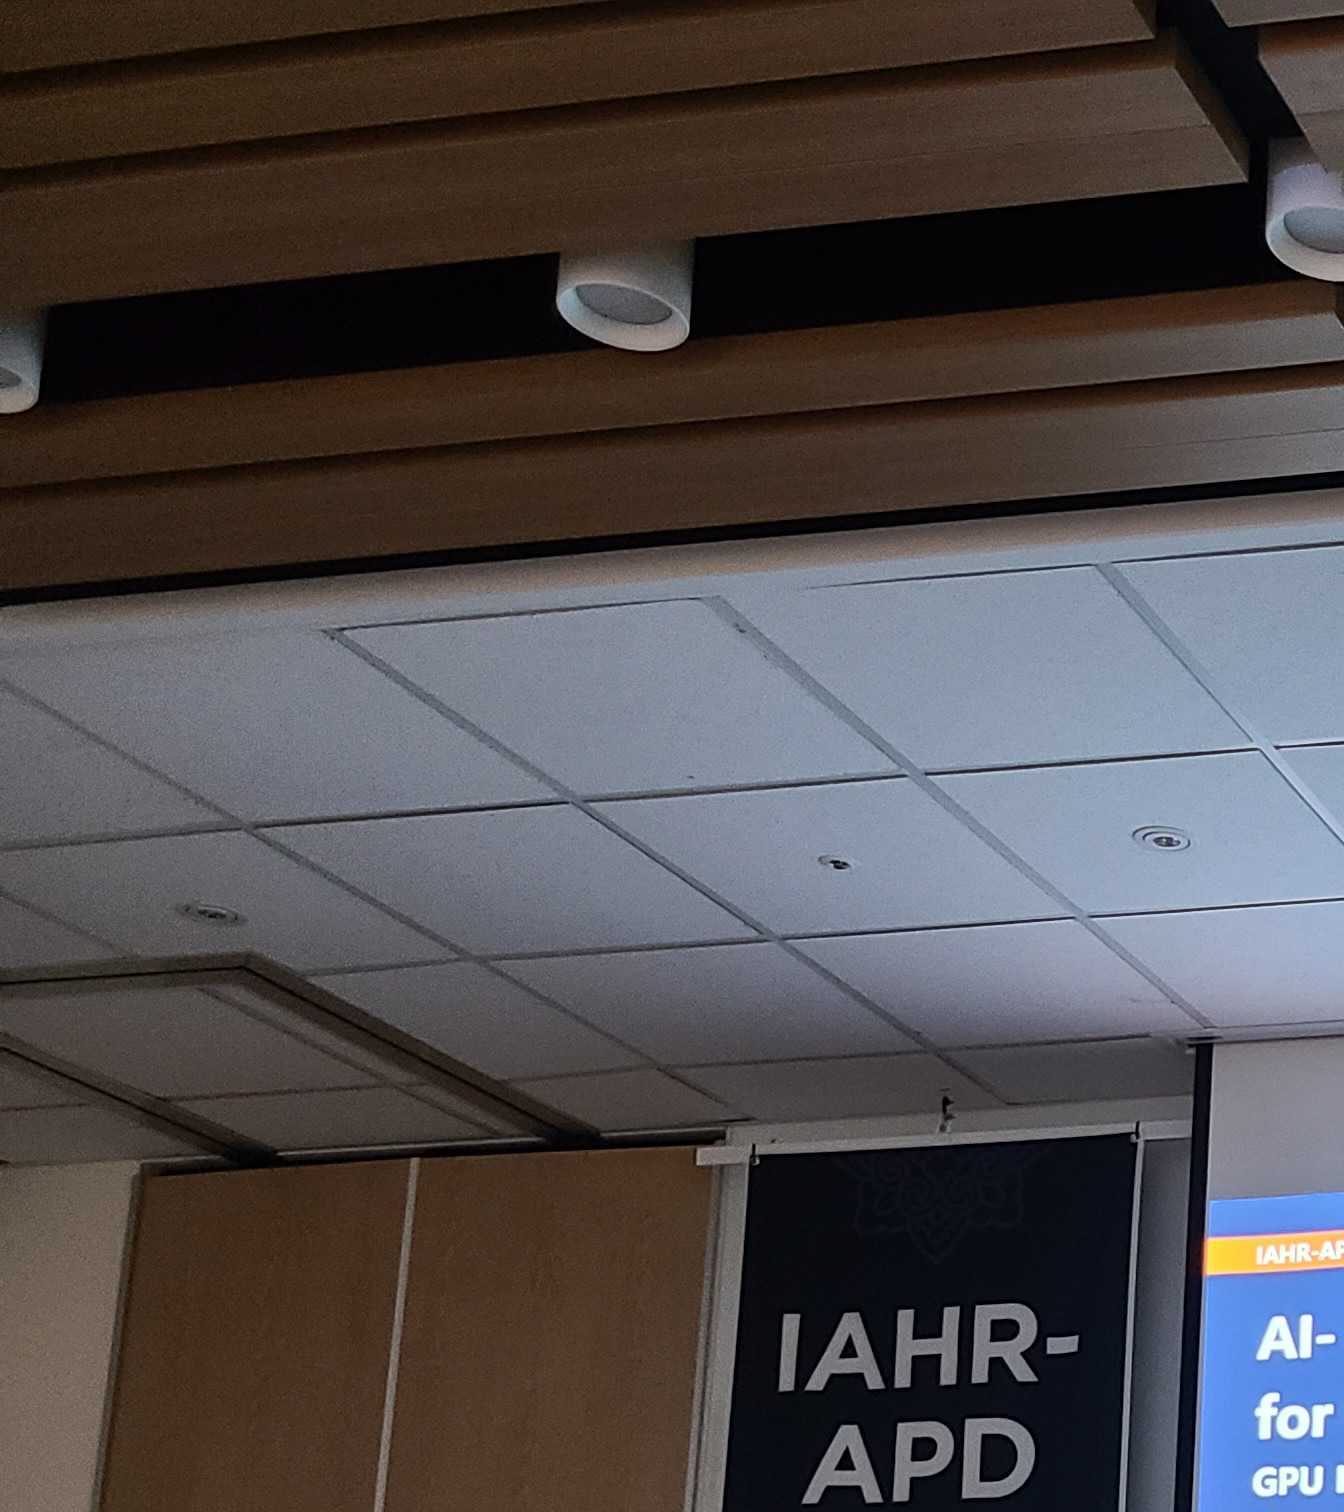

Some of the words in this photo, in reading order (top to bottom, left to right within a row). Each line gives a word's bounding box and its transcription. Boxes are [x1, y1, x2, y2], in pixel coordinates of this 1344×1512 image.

[778, 1303, 1080, 1392] IAHR-
[1255, 1314, 1336, 1360] AI-
[1255, 1391, 1334, 1440] for
[801, 1417, 1036, 1504] APD
[1252, 1465, 1323, 1498] GPU
